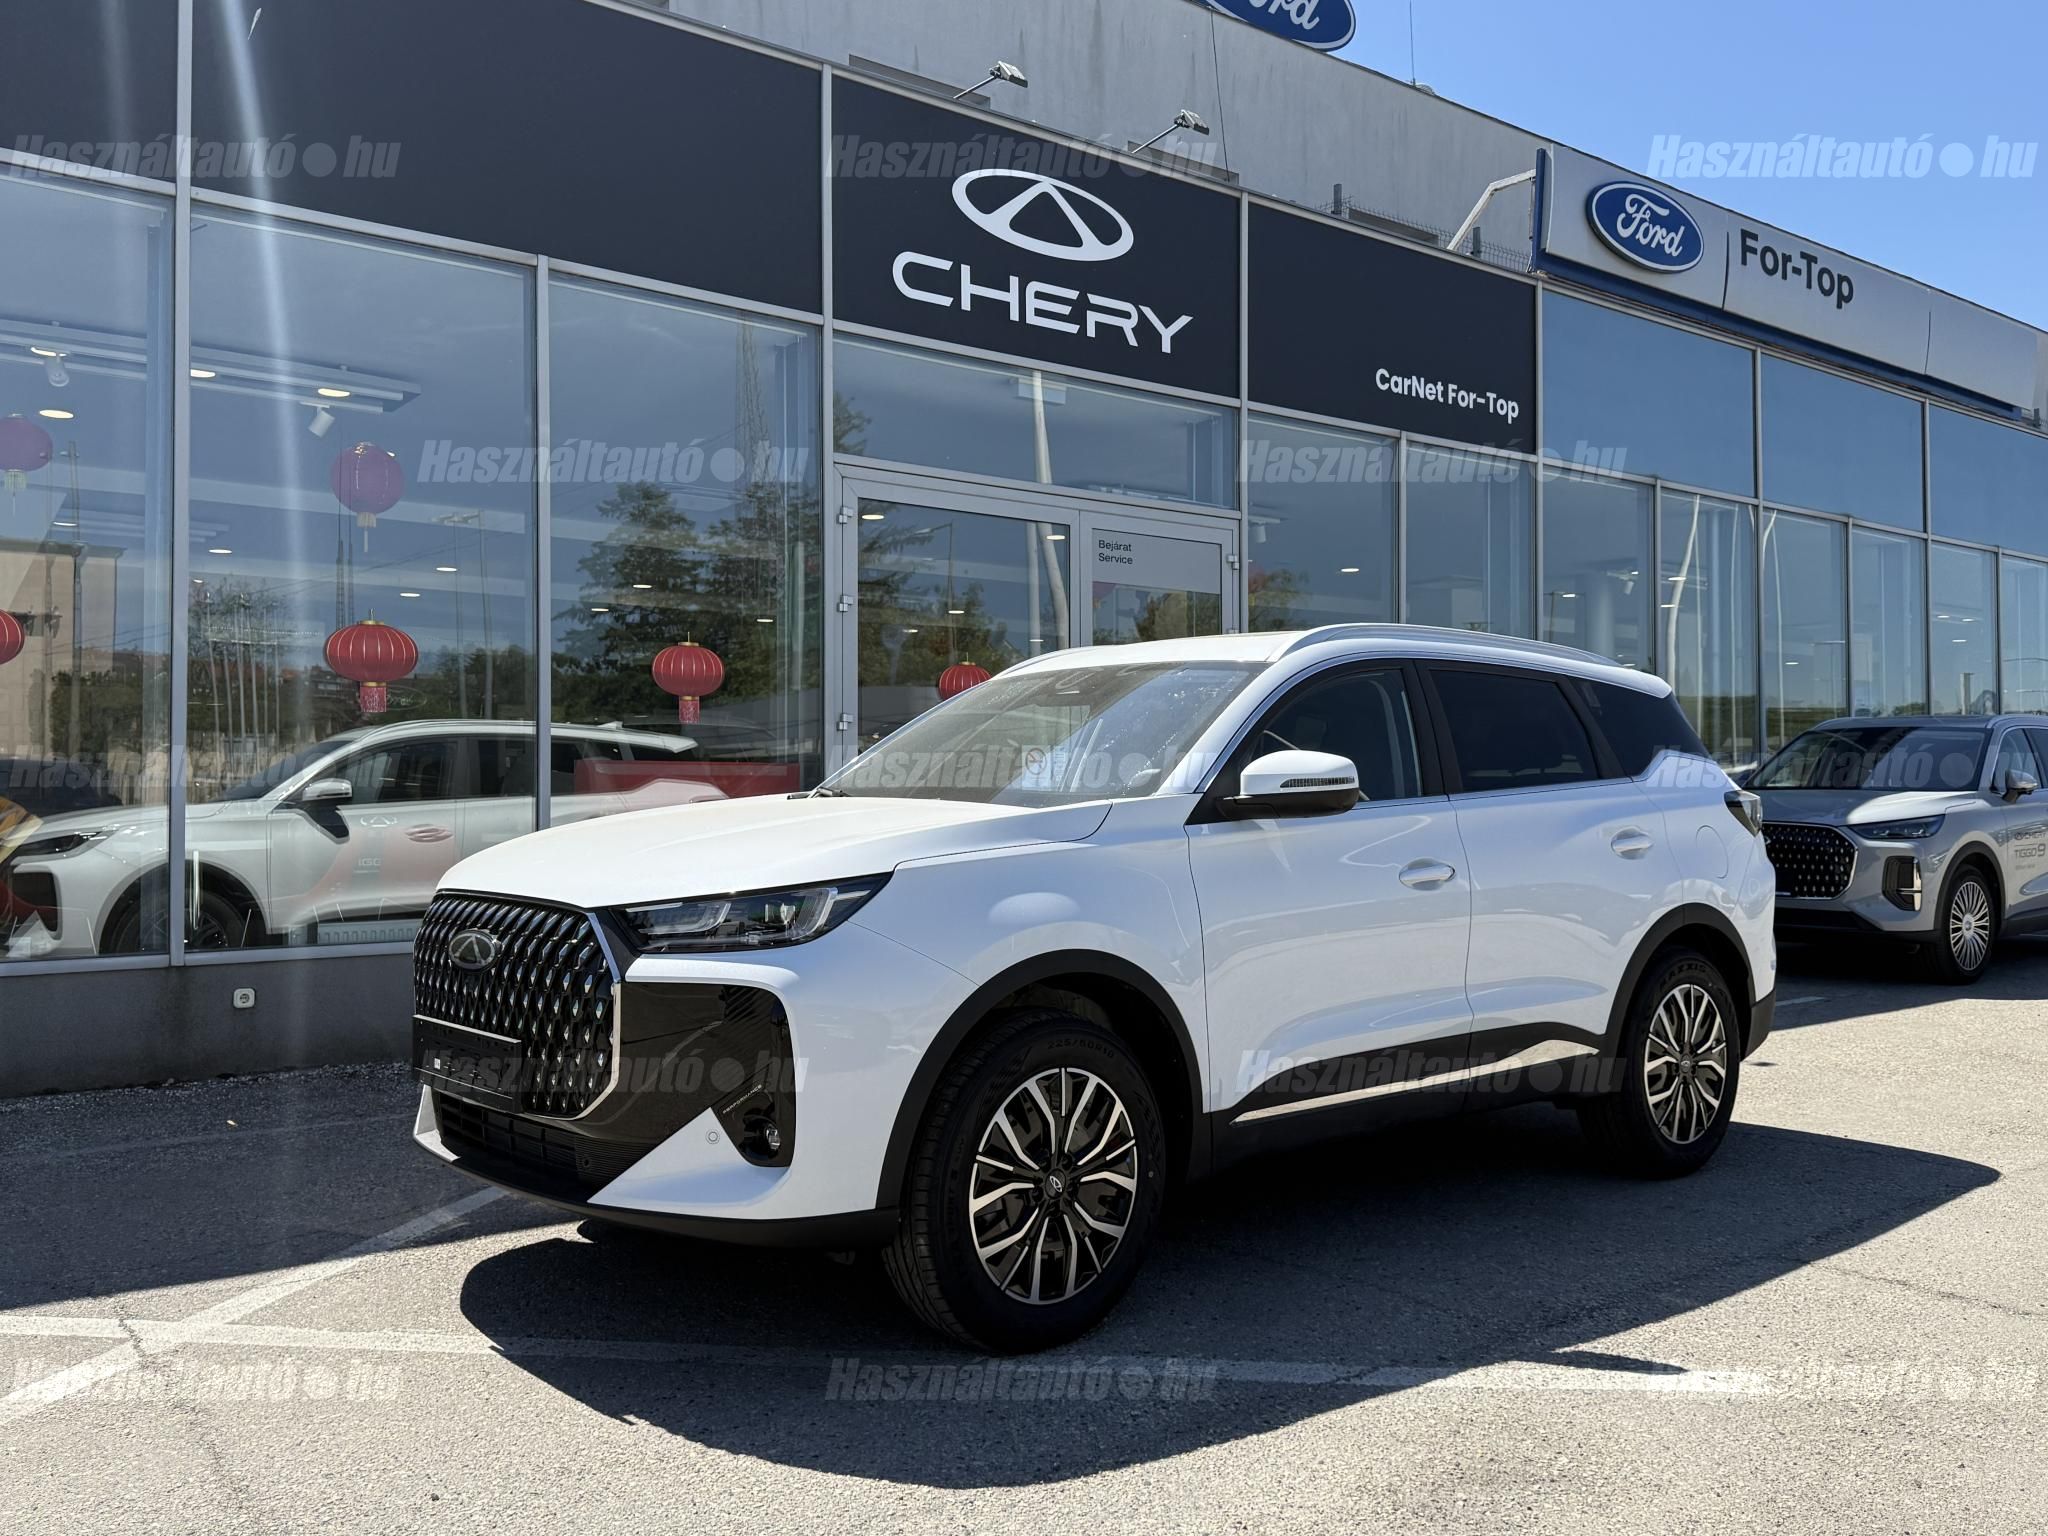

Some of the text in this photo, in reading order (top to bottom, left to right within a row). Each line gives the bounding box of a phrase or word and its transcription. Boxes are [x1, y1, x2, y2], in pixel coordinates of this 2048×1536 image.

[1617, 194, 1684, 257] Ford
[1741, 228, 1853, 309] For-Top
[893, 251, 1194, 354] CHERY
[1375, 368, 1519, 424] CarNet For-Top
[1098, 540, 1132, 552] Bejárat
[1098, 552, 1133, 565] Service
